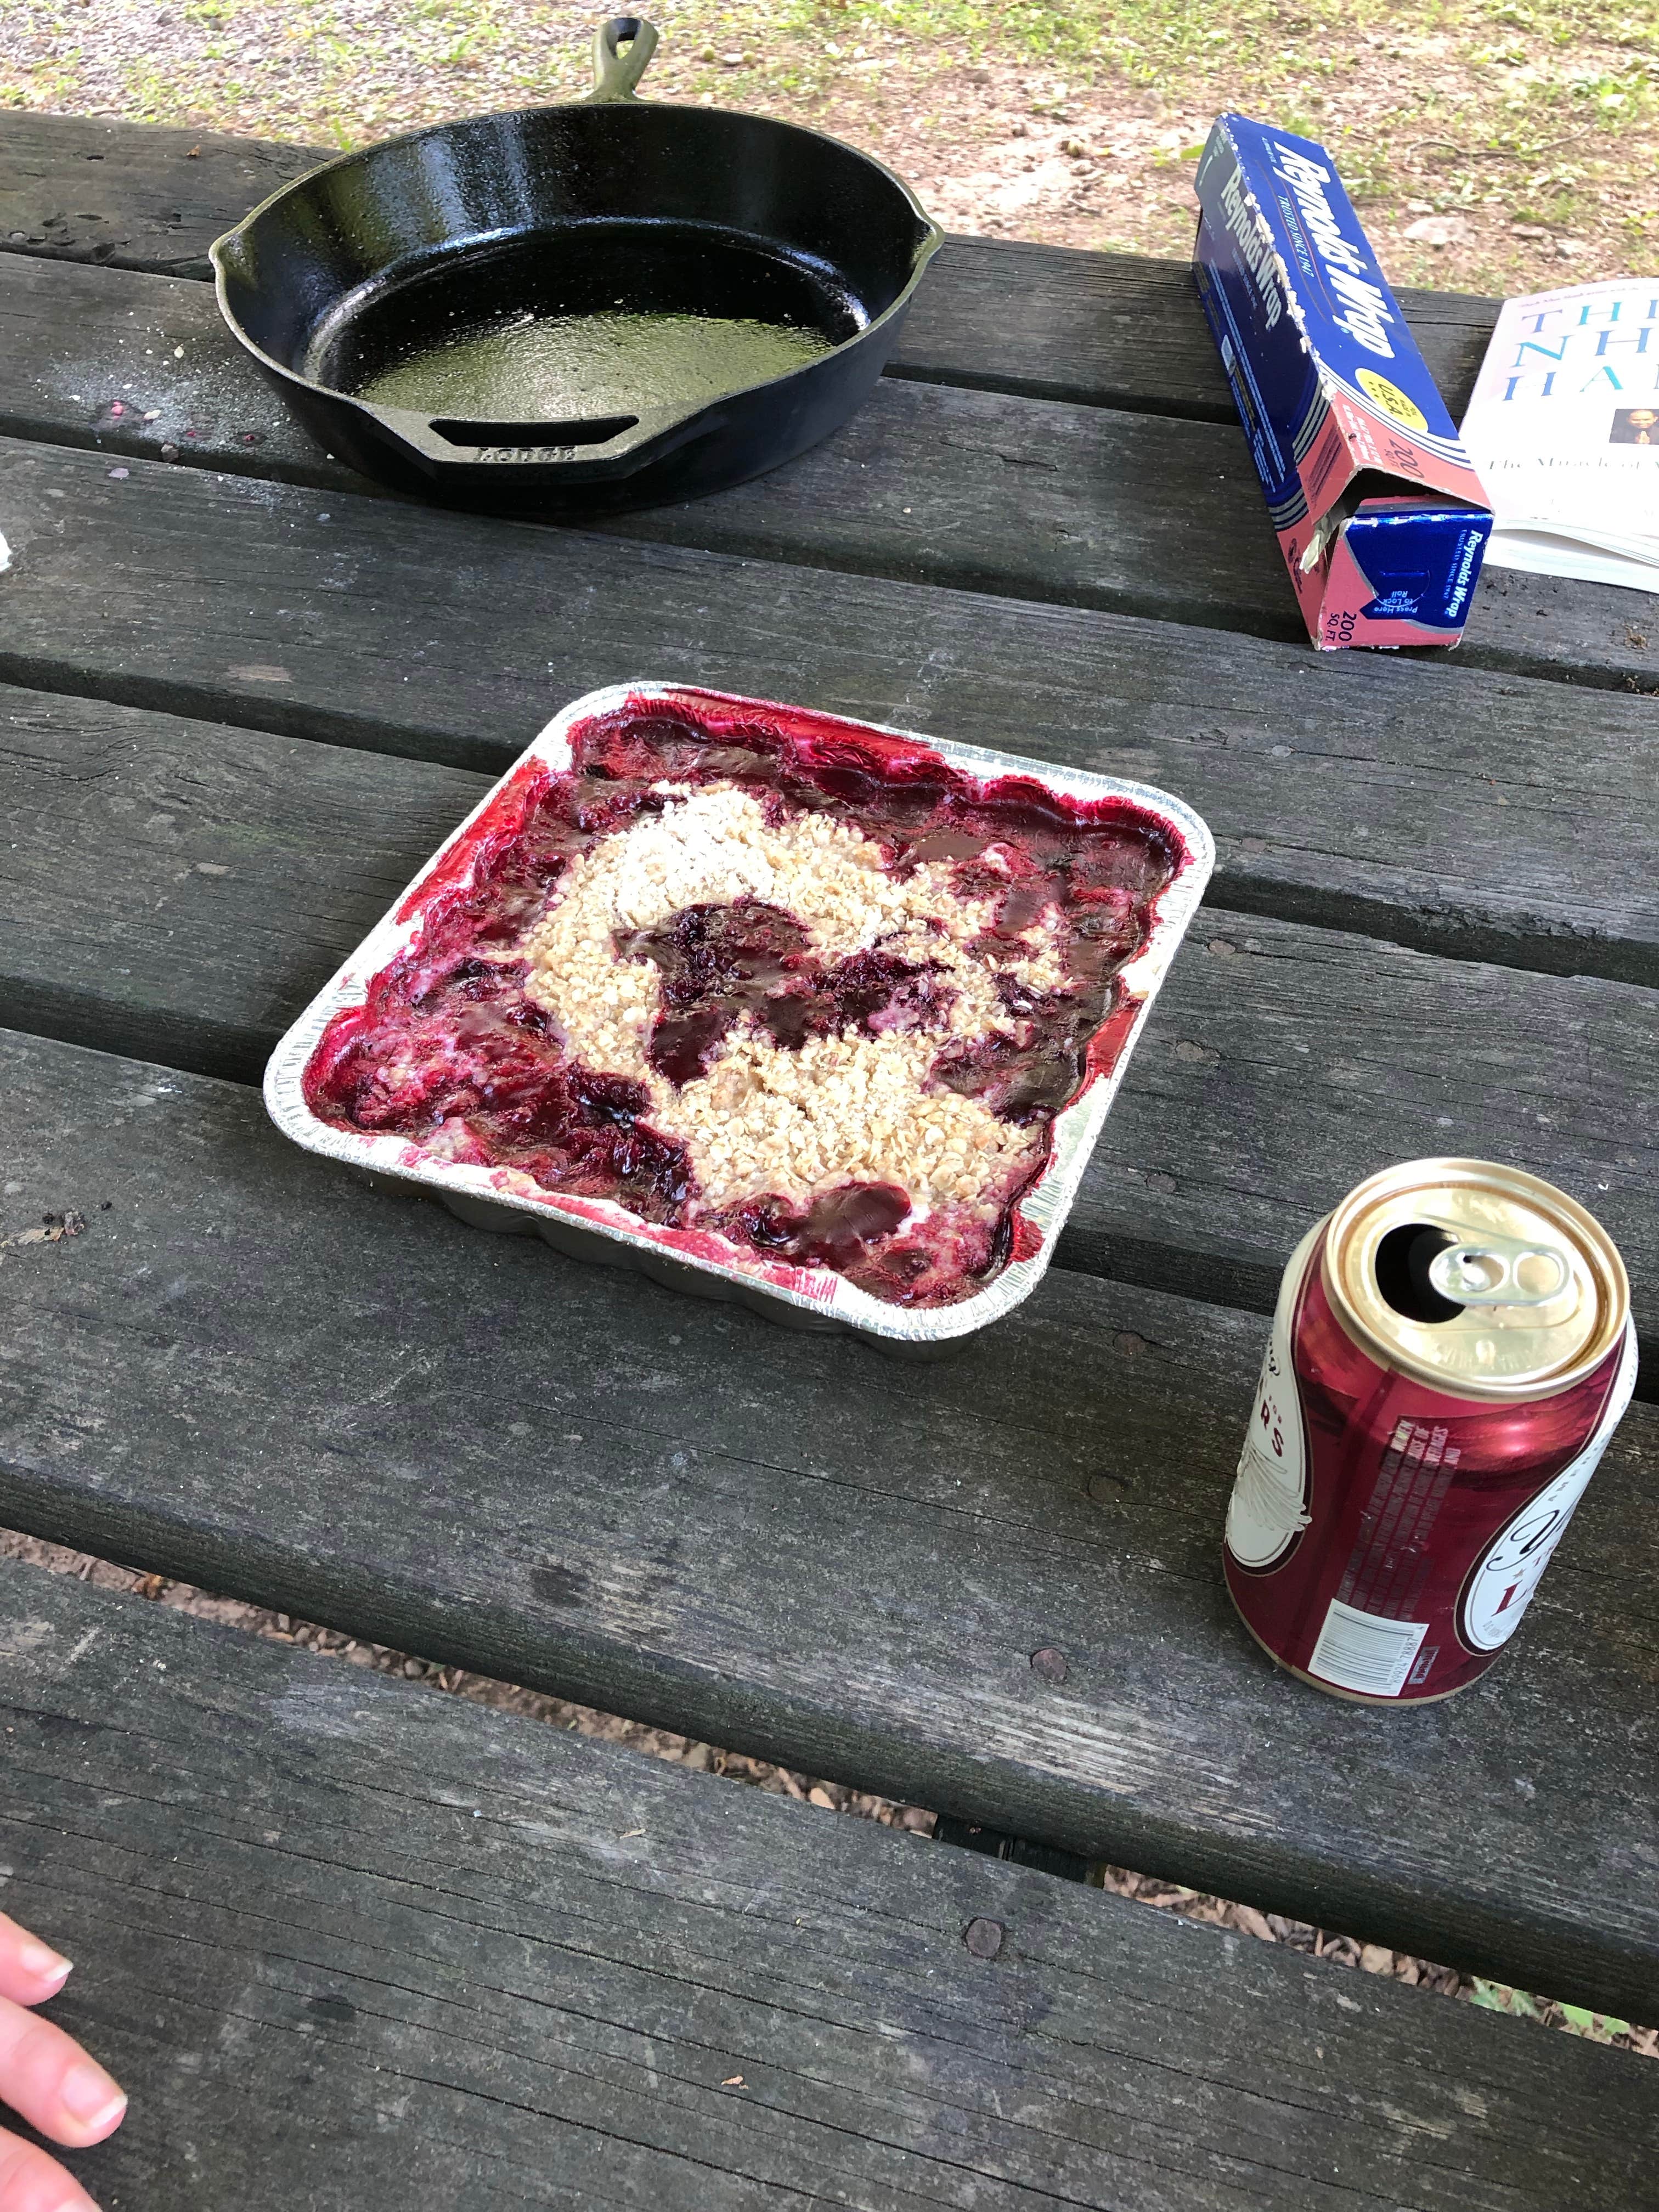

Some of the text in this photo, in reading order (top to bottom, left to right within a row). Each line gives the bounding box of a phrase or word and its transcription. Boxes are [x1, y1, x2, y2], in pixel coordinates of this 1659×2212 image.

[1221, 164, 1266, 273] Reynolds
[1254, 250, 1283, 330] Wrap
[1273, 141, 1368, 275] Reynolds
[1325, 264, 1395, 358] Wrap
[1278, 195, 1314, 278] TRUSTED SINCE 1947
[1378, 383, 1403, 415] U.S.A.
[1389, 438, 1425, 478] 200
[1453, 529, 1468, 560] TRUSTED
[1446, 529, 1483, 618] Reynolds Wrap
[1447, 562, 1458, 583] SINCE
[1325, 612, 1340, 641] SQ. FT.
[1338, 611, 1357, 642] 200
